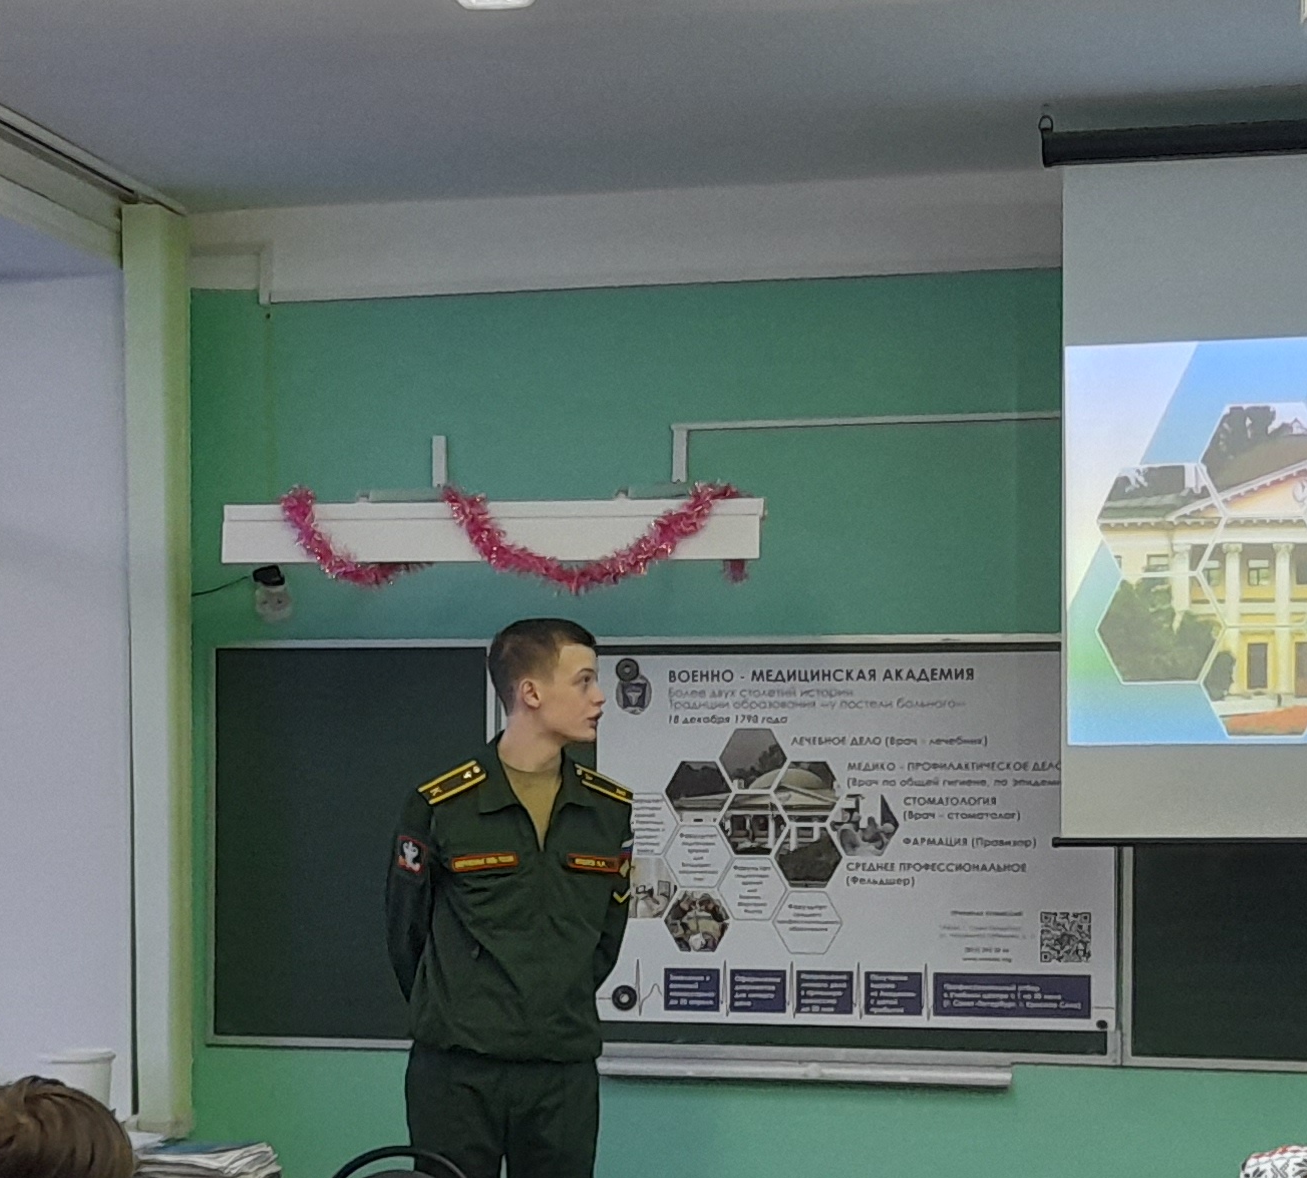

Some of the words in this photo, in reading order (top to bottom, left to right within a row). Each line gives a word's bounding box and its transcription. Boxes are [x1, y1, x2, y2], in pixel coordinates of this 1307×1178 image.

[668, 669, 734, 683] ВОЕННО
[750, 668, 877, 683] МЕДИЦИНСКАЯ
[882, 667, 975, 683] АКАДЕМИЯ
[682, 714, 731, 725] декабря
[791, 736, 846, 746] ЛЕЧЕБНОЕ
[849, 736, 882, 746] ДЕЛО
[847, 762, 896, 771] МЕДИКО
[907, 761, 1029, 772] ПРОФИЛАКТИЧЕСКОЕ
[903, 796, 997, 807] СТОМАТОЛОГИЯ
[902, 837, 968, 848] ФАРМАЦИЯ
[846, 862, 895, 872] СРЕДНЕЕ
[898, 861, 1027, 873] ПРОФЕССИОНАЛЬНОЕ
